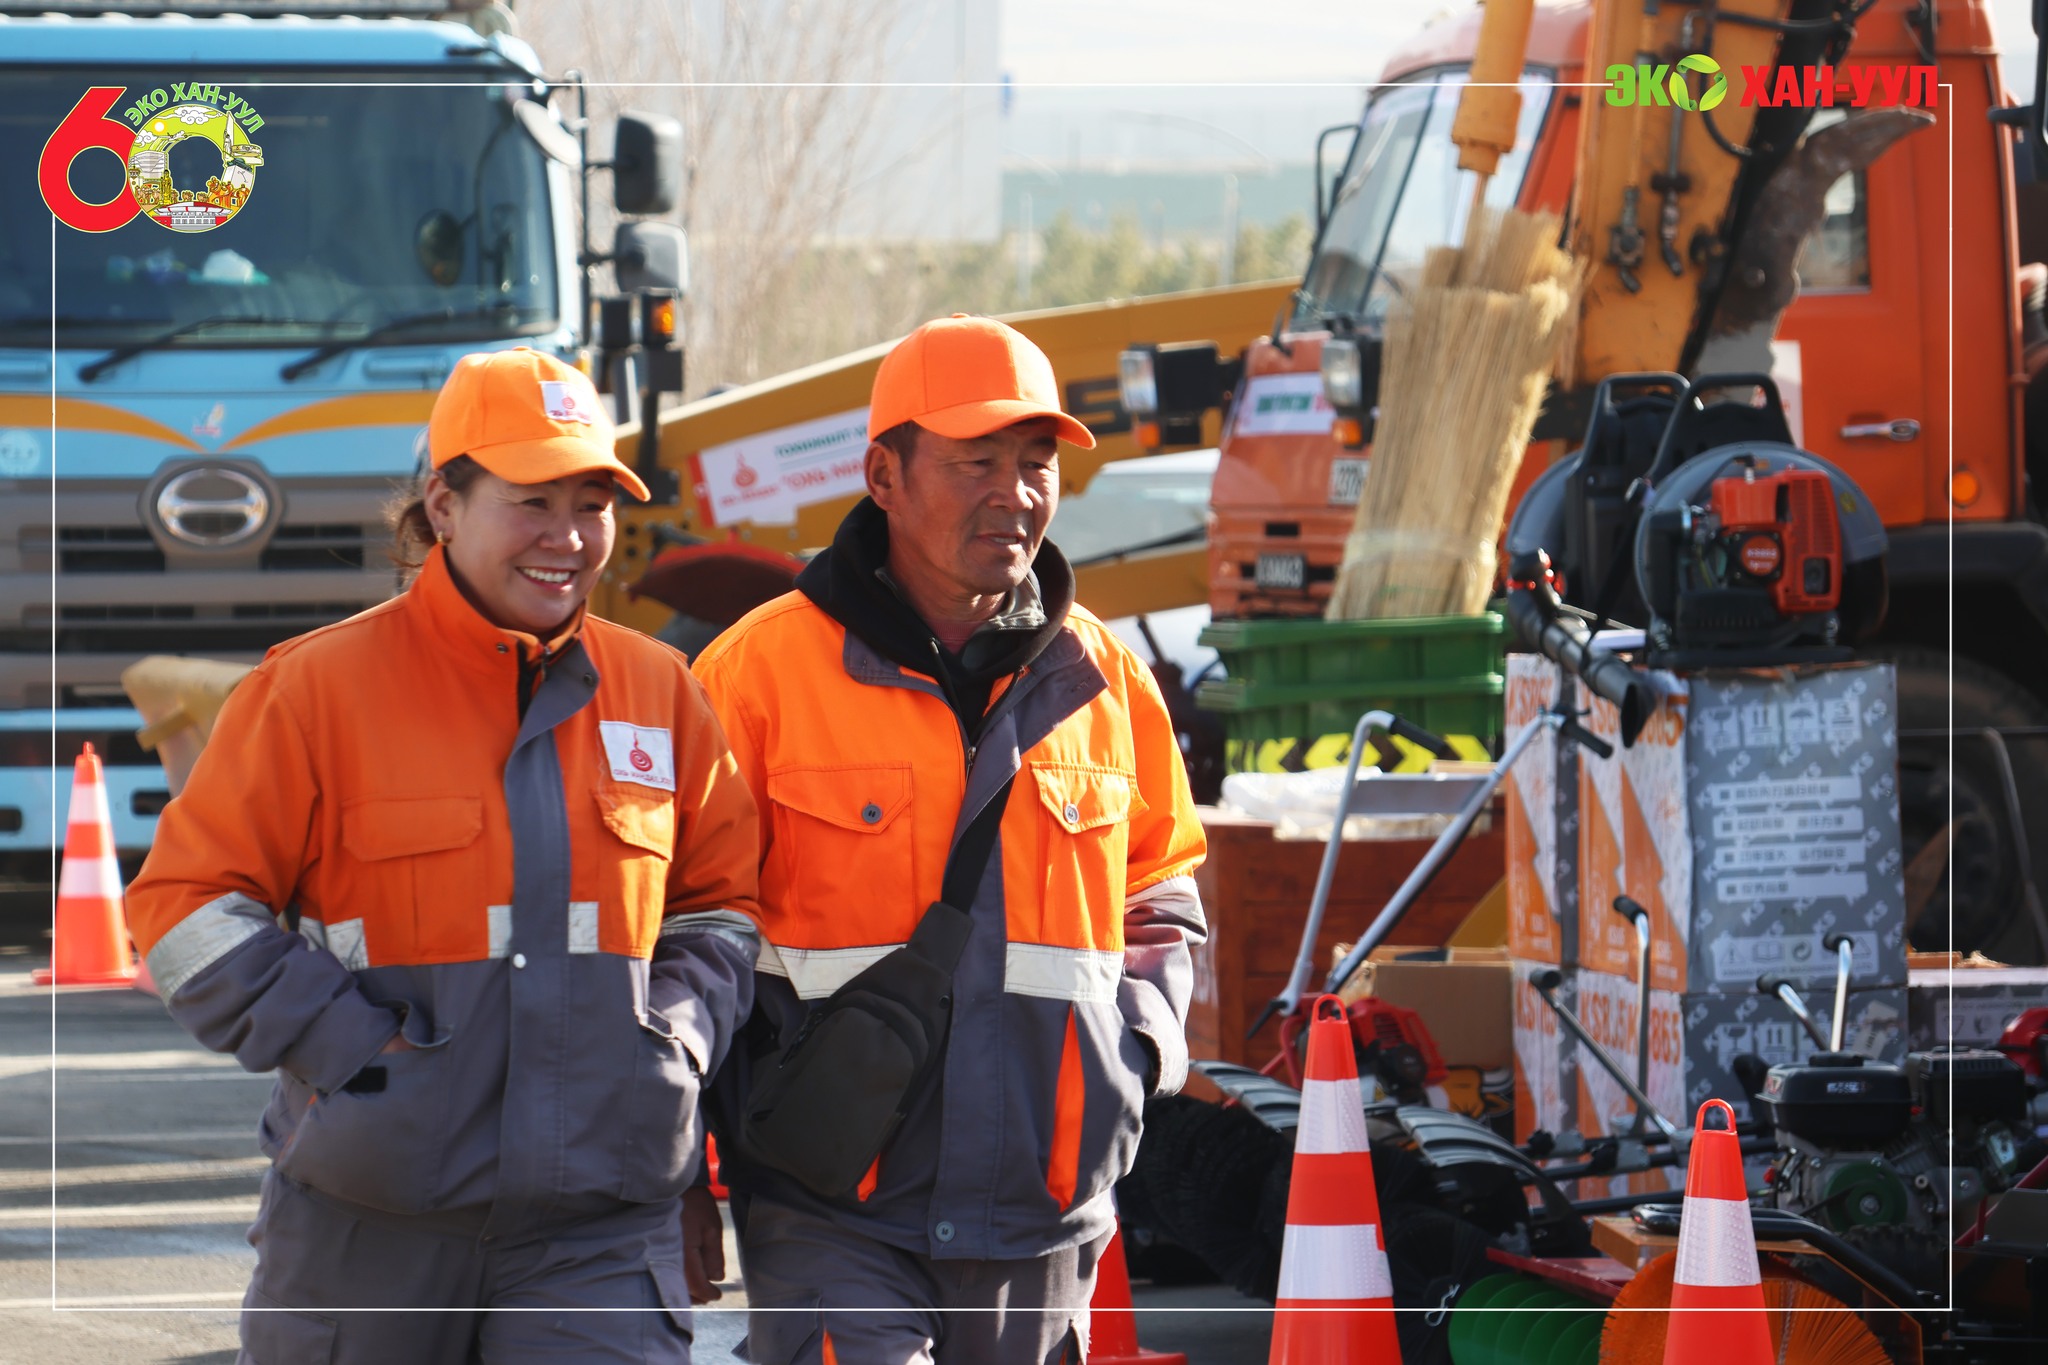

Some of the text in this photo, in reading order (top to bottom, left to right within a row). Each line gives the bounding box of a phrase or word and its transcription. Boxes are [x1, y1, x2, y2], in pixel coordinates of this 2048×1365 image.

[1727, 751, 1750, 778] KS
[1876, 848, 1900, 876] KS
[1742, 901, 1765, 926] KS
[1864, 900, 1888, 928] KS
[1686, 1002, 1709, 1030] KS
[1735, 996, 1758, 1021] KS
[1688, 1077, 1713, 1105] KS
